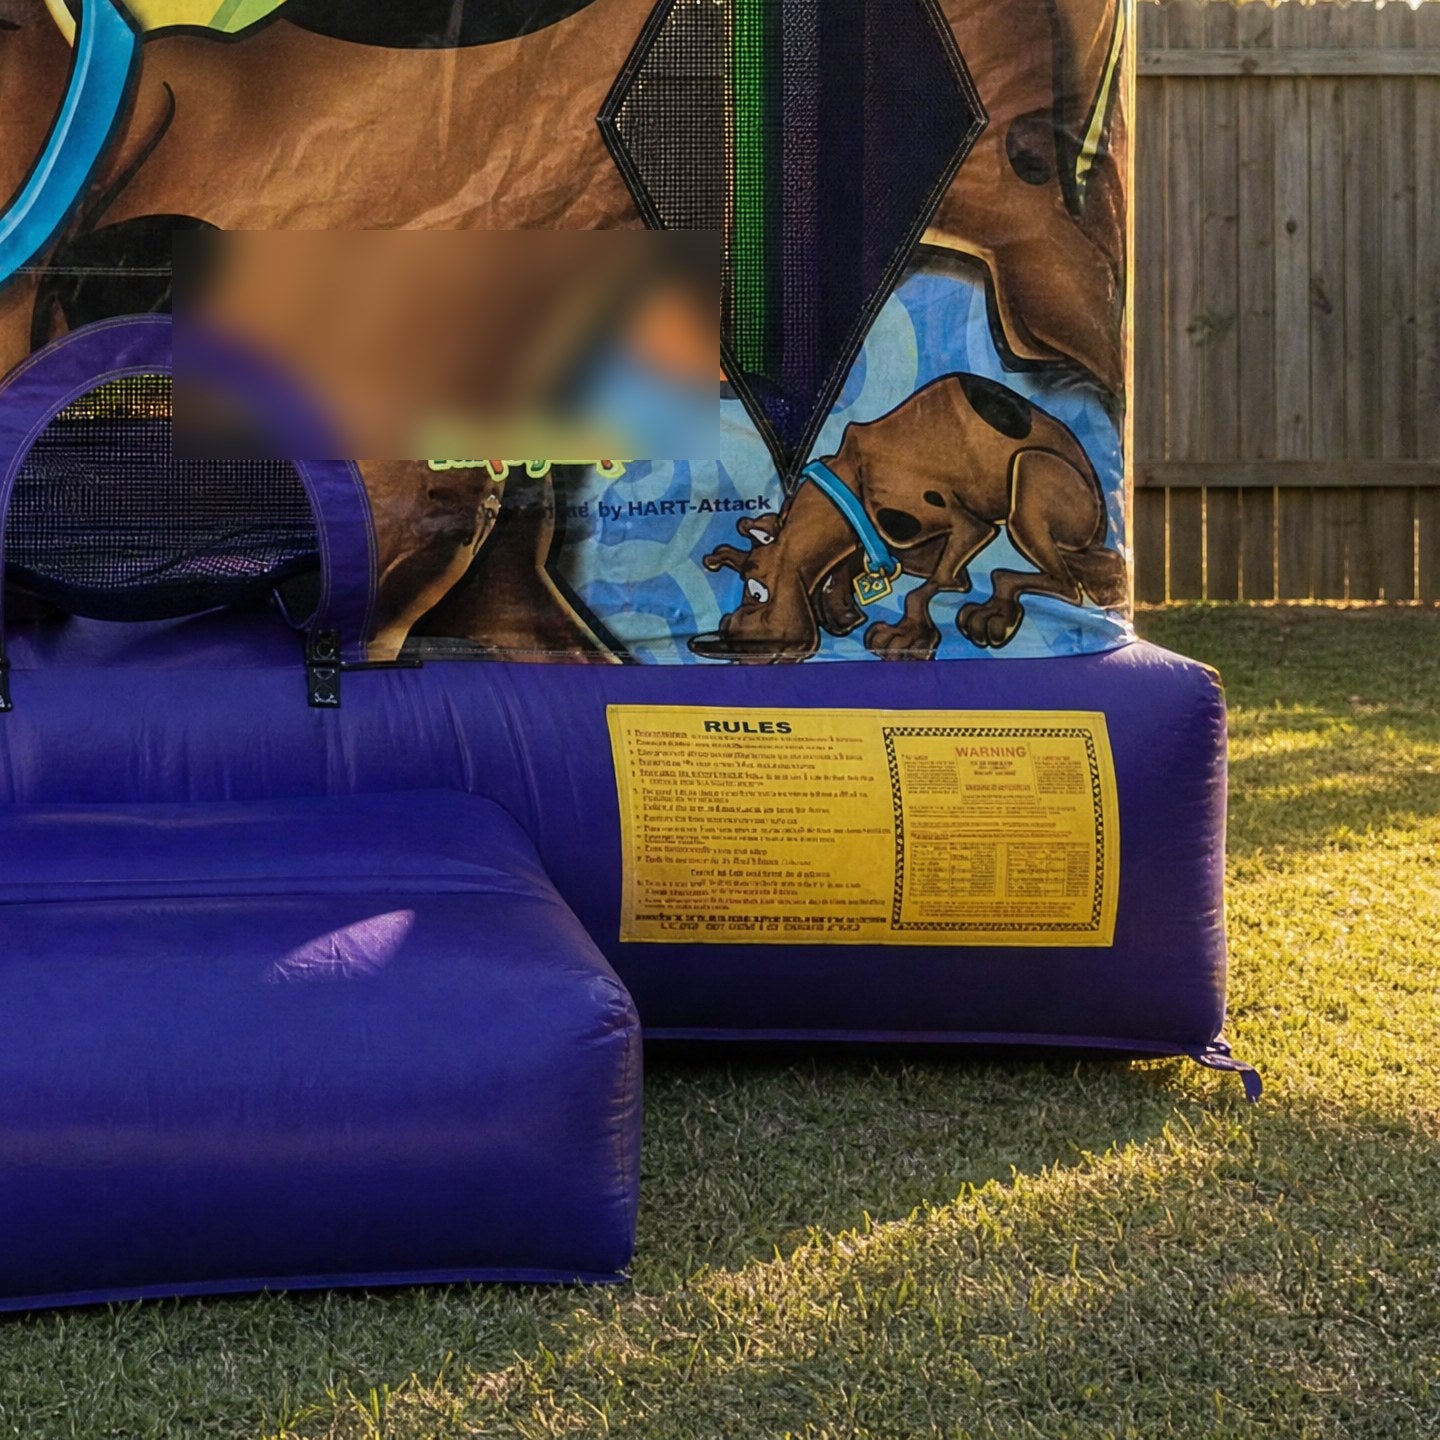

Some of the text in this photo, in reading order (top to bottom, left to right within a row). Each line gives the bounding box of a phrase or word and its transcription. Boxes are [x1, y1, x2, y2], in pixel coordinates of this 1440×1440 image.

[598, 501, 623, 522] by
[628, 495, 772, 517] HART-Attack
[703, 720, 793, 735] RULES
[955, 746, 1027, 758] WARNING
